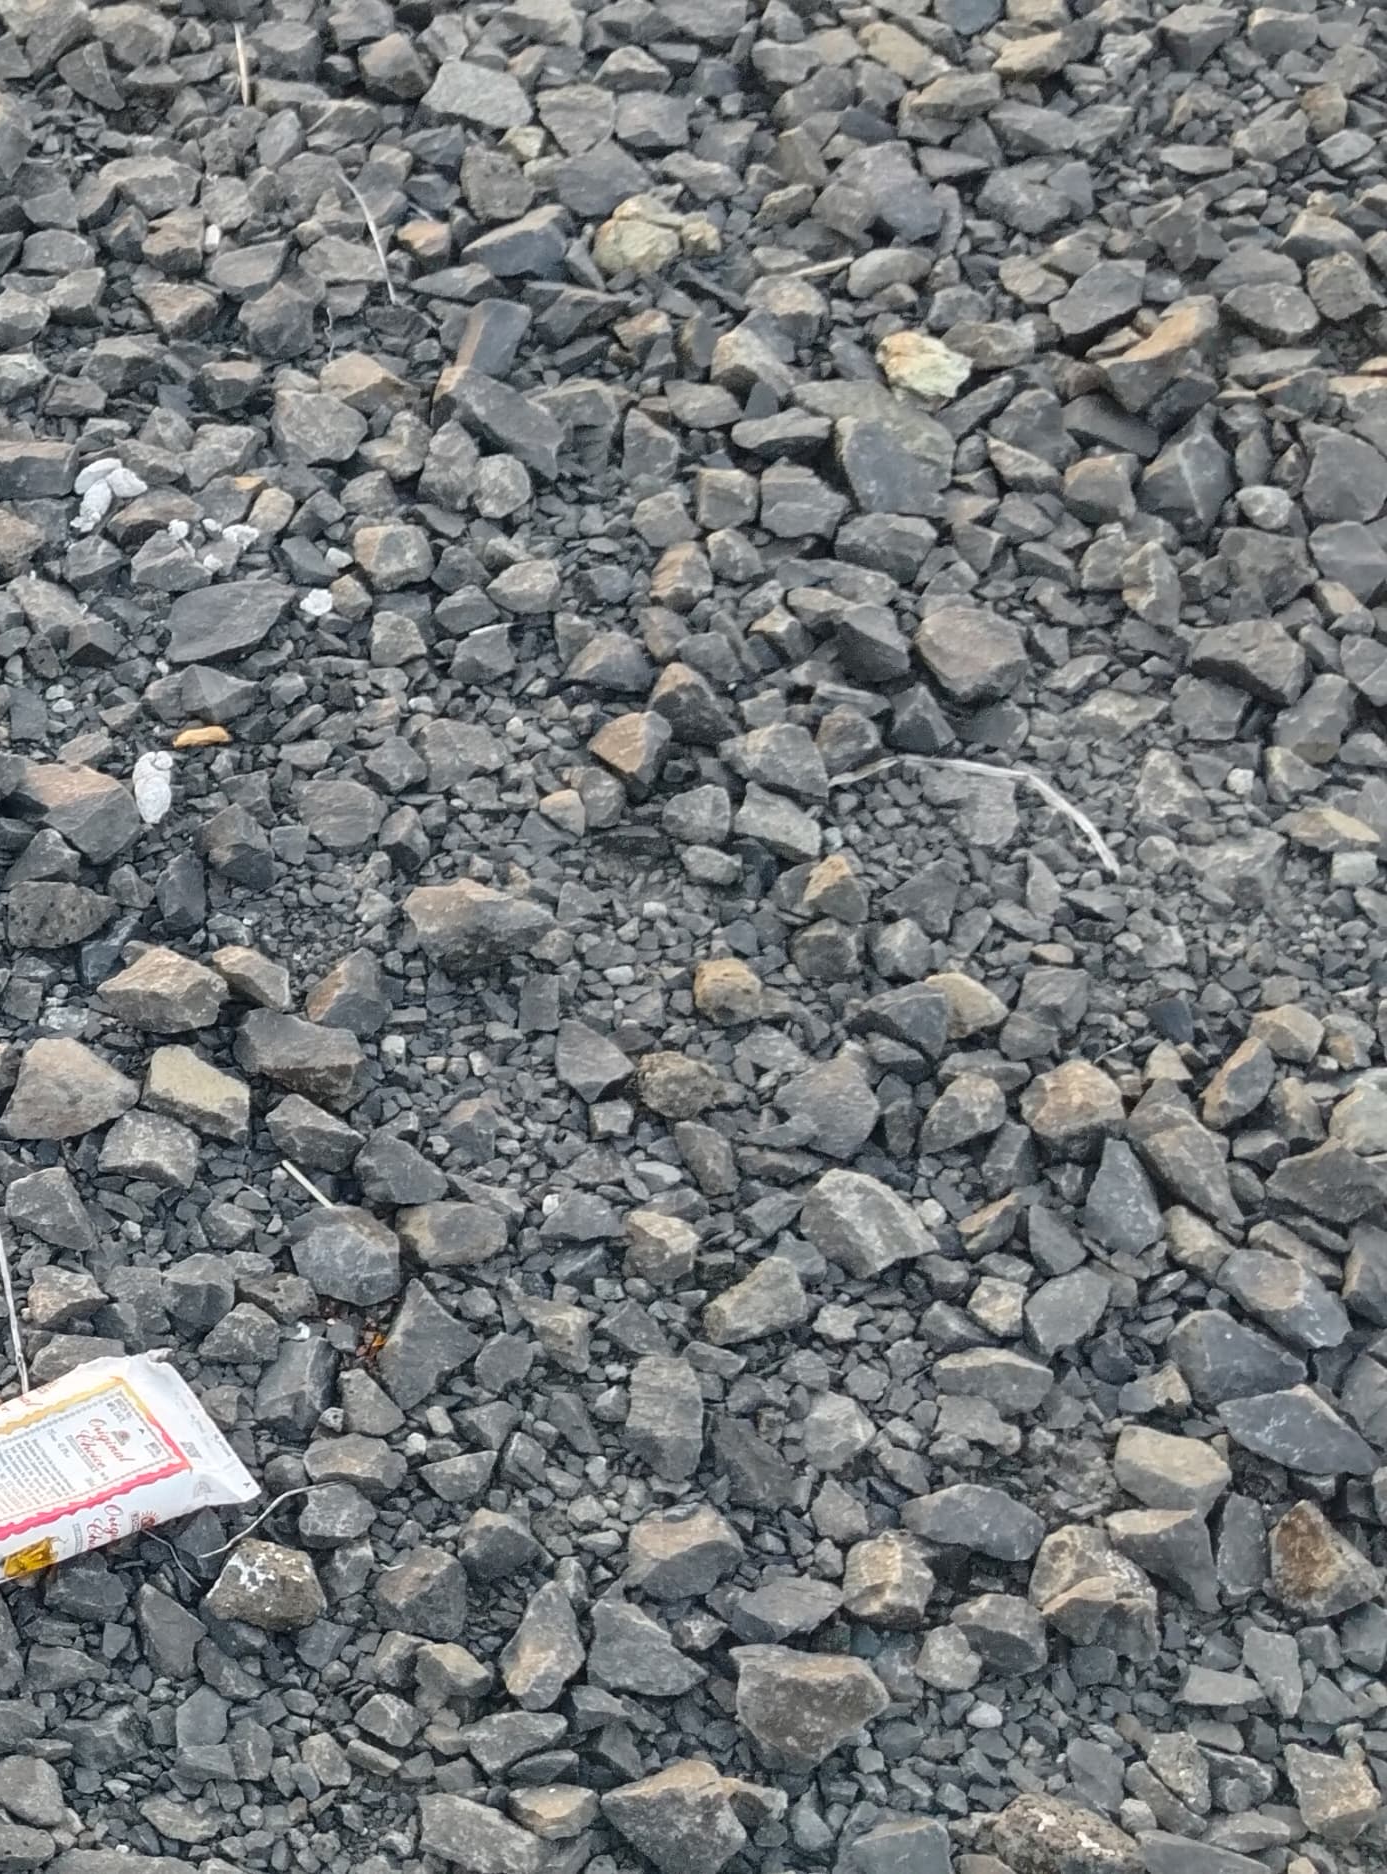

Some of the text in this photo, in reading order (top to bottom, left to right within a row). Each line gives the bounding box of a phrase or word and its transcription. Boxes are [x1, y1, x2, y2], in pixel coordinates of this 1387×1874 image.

[74, 1429, 107, 1472] Choice
[87, 1417, 136, 1464] Original
[86, 1517, 104, 1550] Ch
[103, 1503, 124, 1541] Orig
